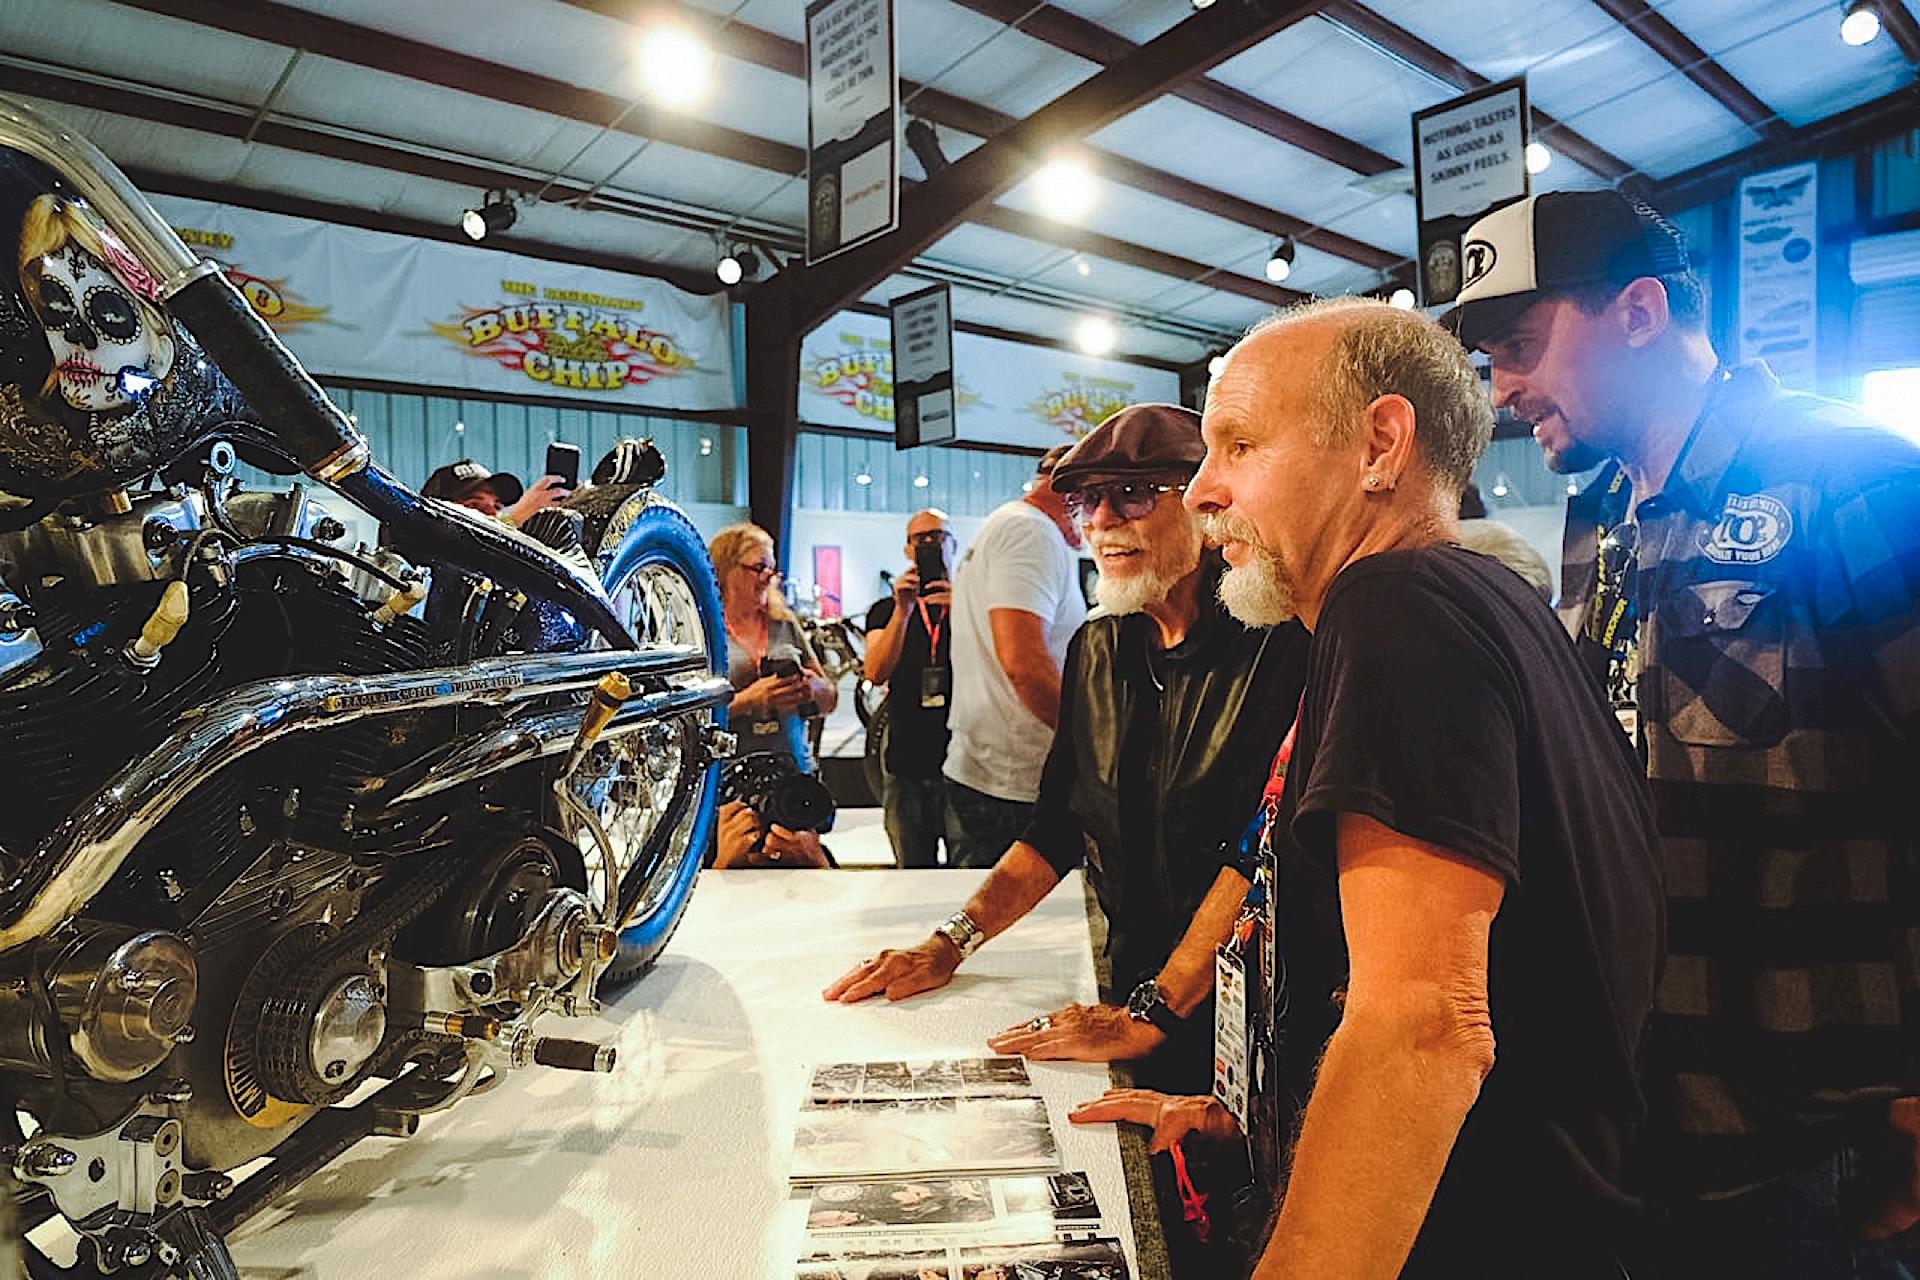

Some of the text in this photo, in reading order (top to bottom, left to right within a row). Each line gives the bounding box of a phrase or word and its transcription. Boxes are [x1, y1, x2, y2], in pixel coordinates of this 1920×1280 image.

[1423, 105, 1516, 144] NOTHING TASTES
[1437, 130, 1505, 162] AS GOOD AS
[1430, 161, 1470, 184] SKINNY
[463, 302, 679, 365] BUFFALO
[523, 350, 630, 390] CHIP
